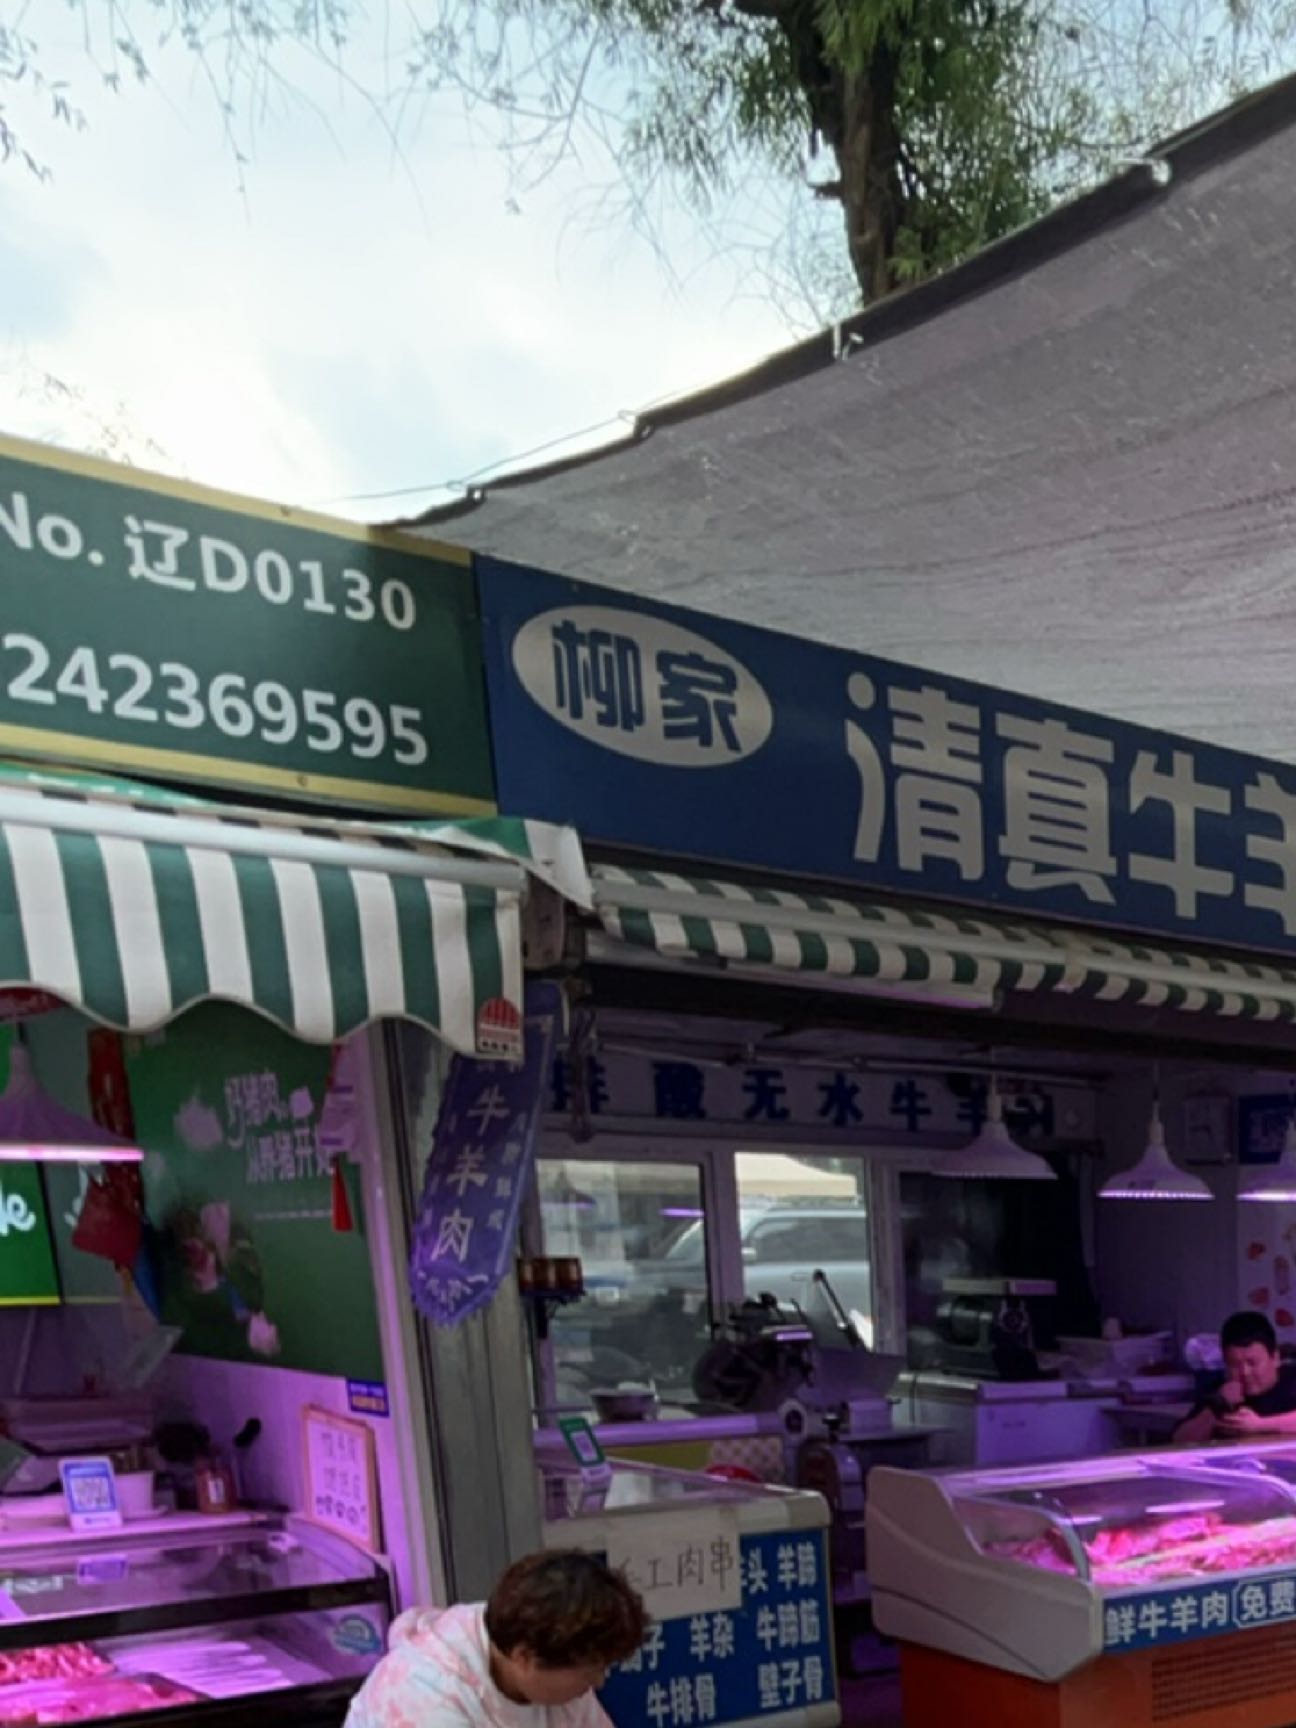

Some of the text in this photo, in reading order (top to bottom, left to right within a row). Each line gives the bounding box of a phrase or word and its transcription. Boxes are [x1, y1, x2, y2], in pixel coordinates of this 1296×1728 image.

[125, 517, 417, 631] 辽D0130
[2, 637, 429, 766] 242369595
[551, 618, 743, 753] 柳家
[689, 1612, 735, 1663] 羊杂
[1104, 1590, 1229, 1646] 鲜牛羊肉
